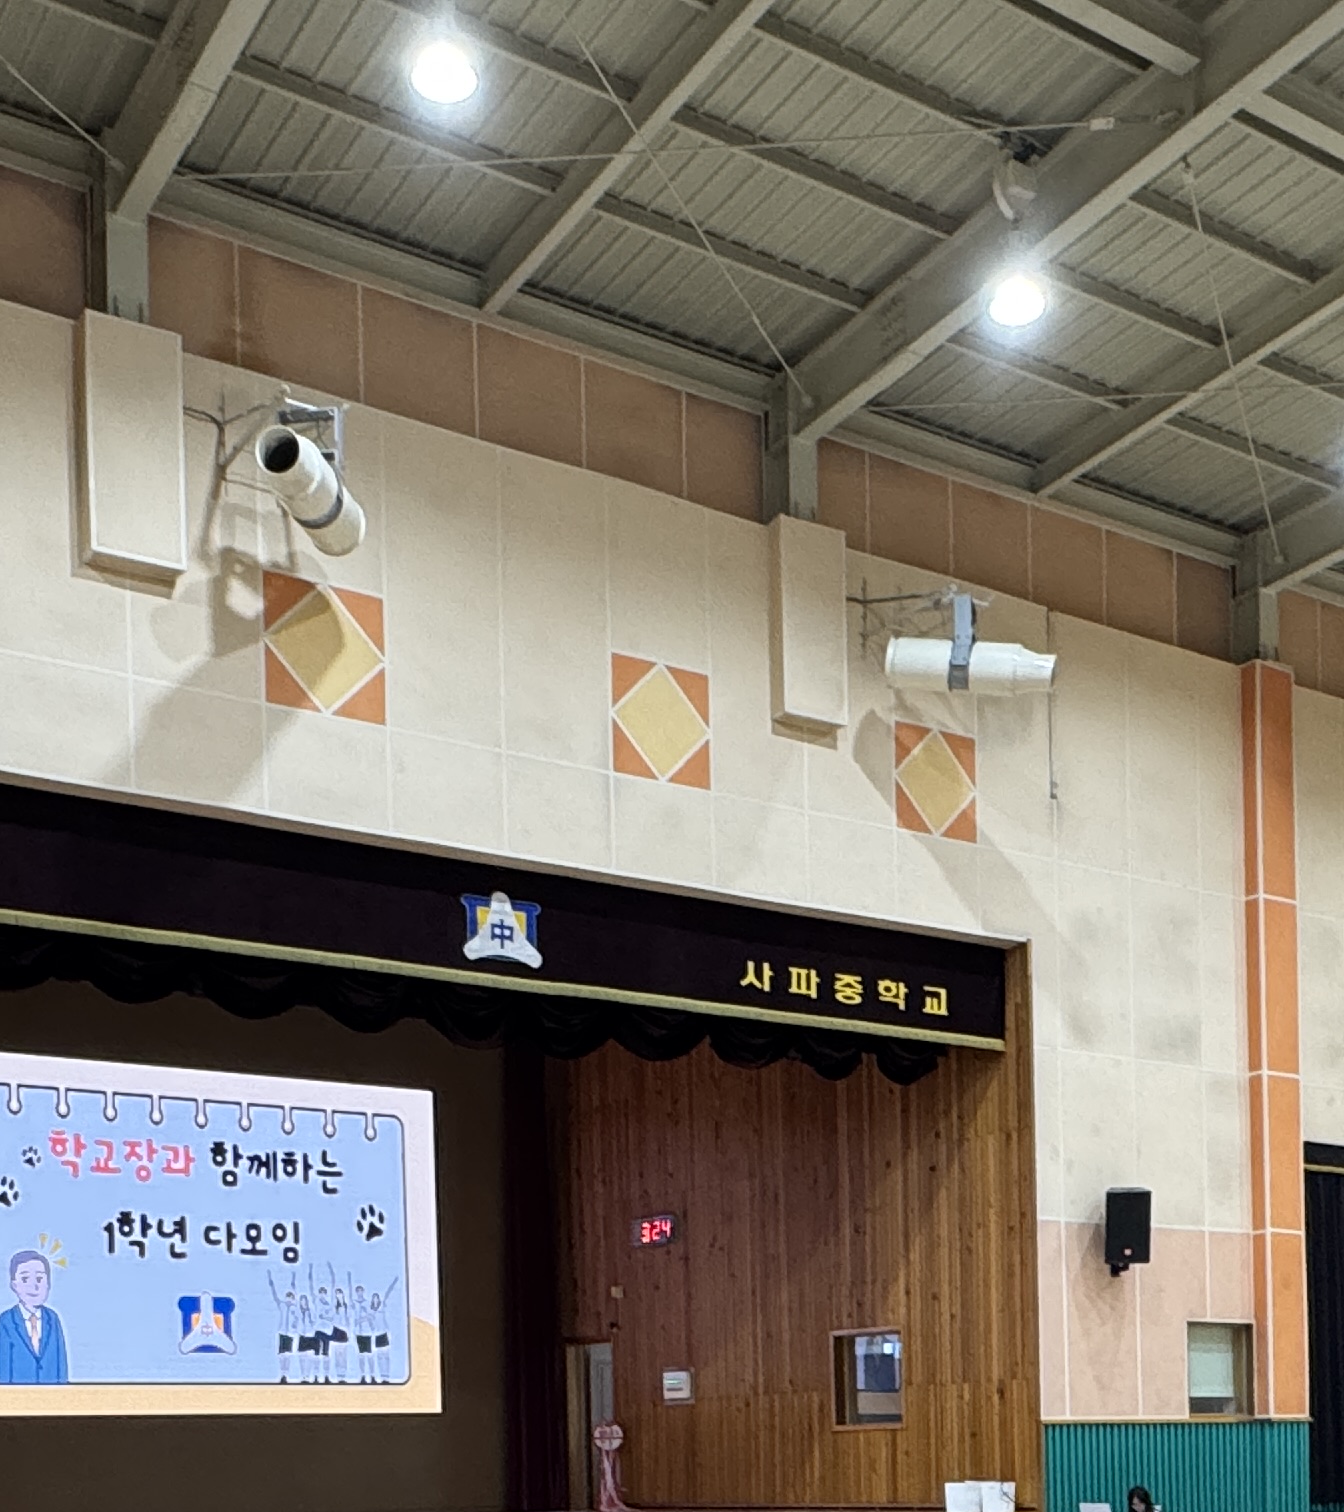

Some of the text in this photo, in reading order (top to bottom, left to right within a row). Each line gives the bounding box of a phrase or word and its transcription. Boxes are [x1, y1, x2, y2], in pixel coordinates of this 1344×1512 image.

[490, 918, 514, 950] 中
[739, 960, 949, 1016] 사파중학교
[48, 1129, 343, 1195] 학교장과 함께하는
[103, 1211, 300, 1263] 1학년 다모임
